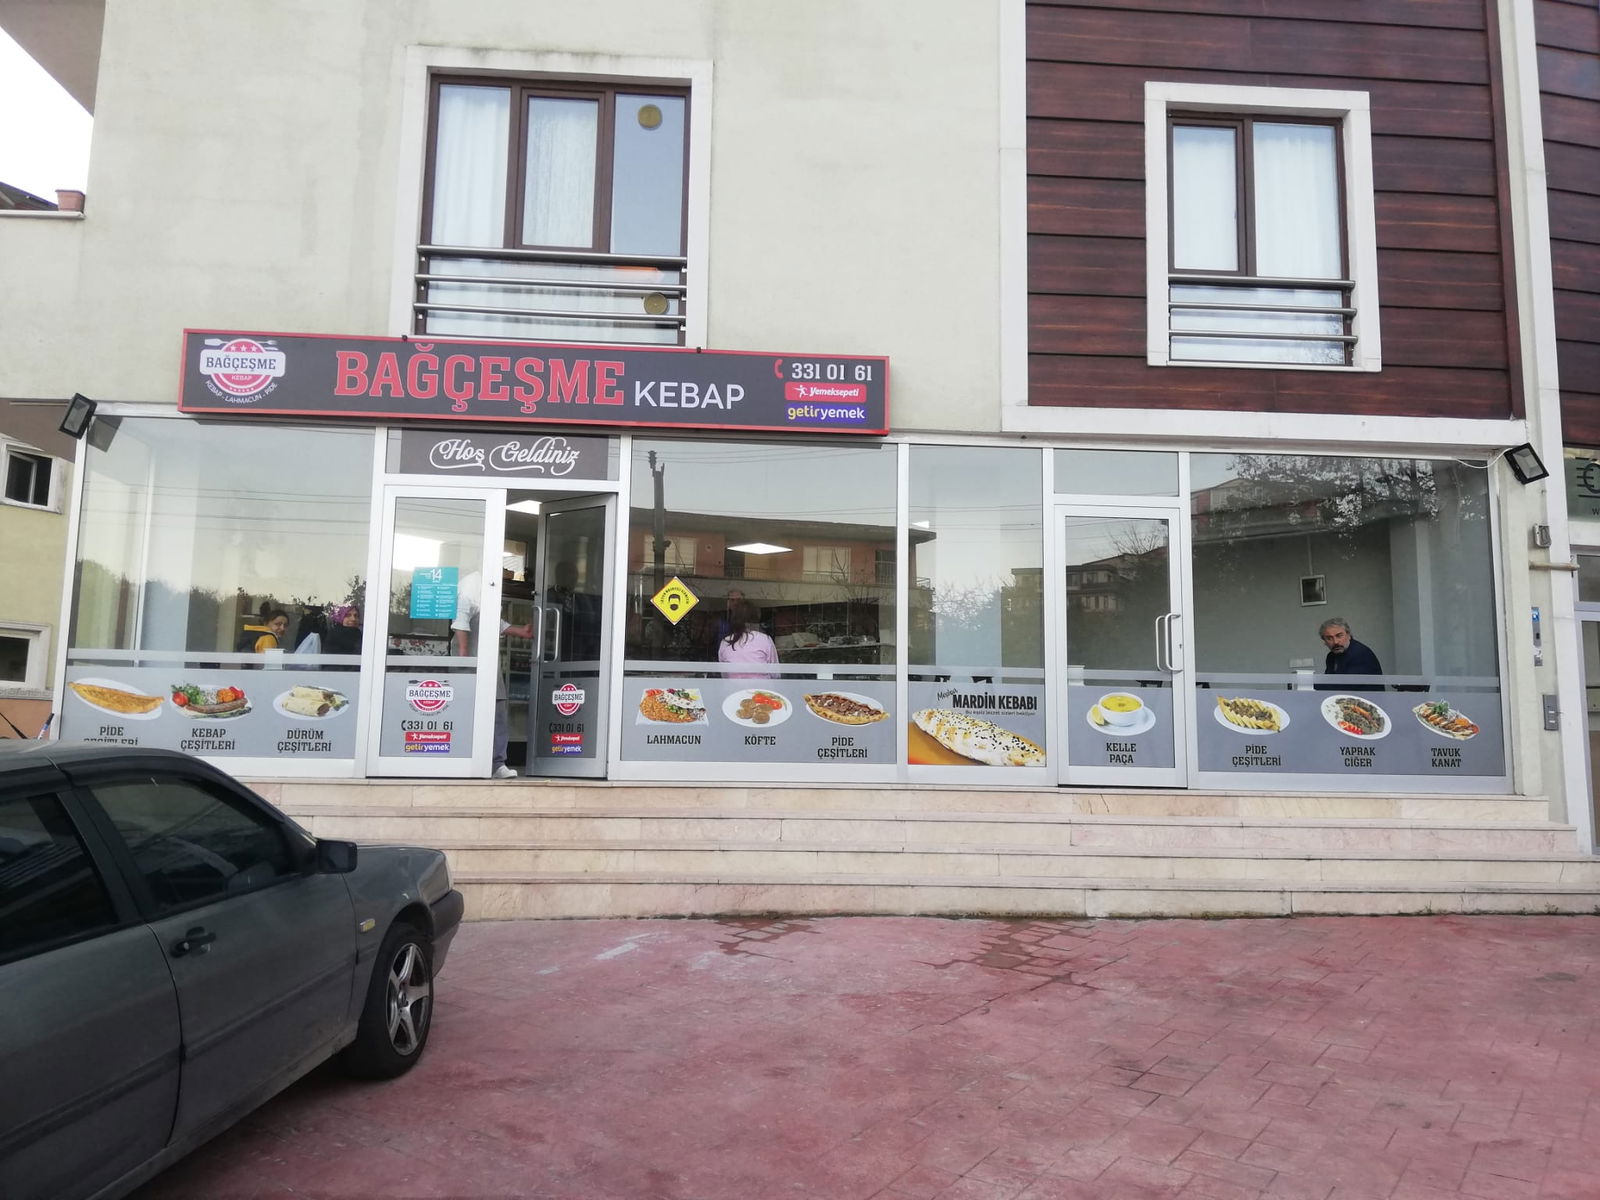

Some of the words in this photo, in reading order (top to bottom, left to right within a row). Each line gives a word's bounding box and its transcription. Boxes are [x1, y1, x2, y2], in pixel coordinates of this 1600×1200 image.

[206, 354, 276, 372] BAĞÇEŞME
[791, 362, 820, 379] 331
[827, 364, 845, 380] 01
[854, 365, 872, 381] 61
[334, 343, 625, 414] BAĞÇEŞME
[634, 380, 745, 410] KEBAP
[787, 405, 865, 420] getiryemek
[429, 439, 486, 471] Hoş
[489, 436, 580, 476] Geldiniz
[430, 568, 442, 581] 14
[409, 689, 451, 699] BAĞÇEŞME
[952, 691, 996, 709] MARDİN
[998, 695, 1037, 710] KEBABI
[99, 725, 125, 736] PİDE
[407, 720, 424, 730] 331
[427, 721, 437, 730] 01
[443, 721, 453, 731] 61
[191, 727, 226, 738] KEBAP
[286, 728, 324, 740] DÜRÜM
[180, 739, 235, 750] ÇEŞİTLERİ
[646, 735, 701, 745] LAHMACUN
[744, 734, 776, 745] KÖFTE
[831, 735, 854, 747] PİDE
[277, 740, 332, 752] ÇEŞİTLERİ
[1106, 742, 1136, 752] KELLE
[1245, 743, 1267, 755] PİDE
[1339, 747, 1376, 757] YAPRAK
[1431, 747, 1461, 757] TAVUK
[817, 748, 868, 759] ÇEŞİTLERİ
[1109, 753, 1134, 765] PAÇA
[1232, 755, 1281, 767] ÇEŞİTLERİ
[1344, 756, 1372, 768] CİĞER
[1431, 757, 1462, 768] KANAT
